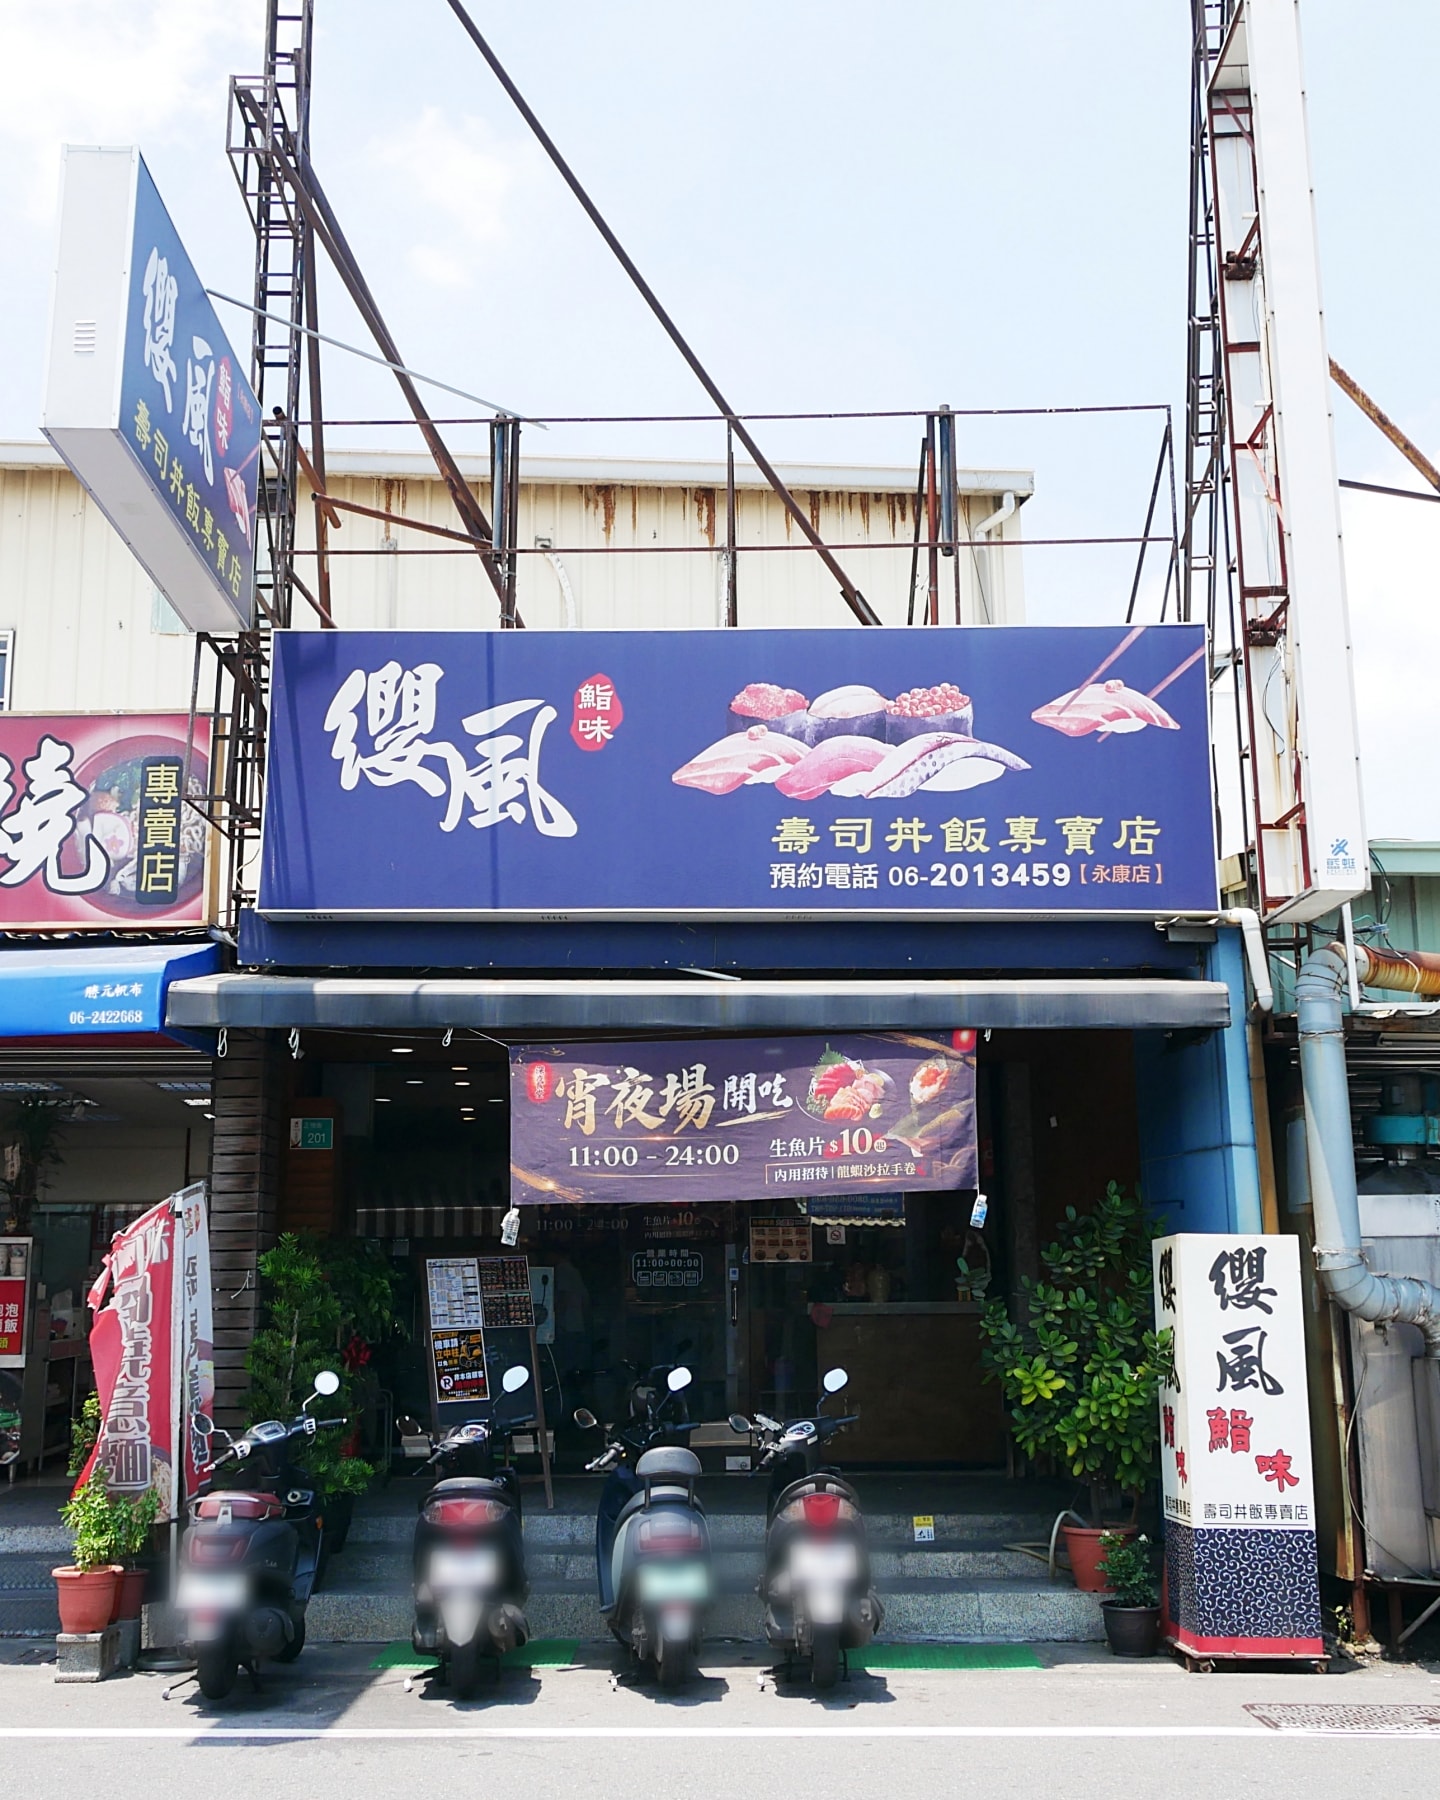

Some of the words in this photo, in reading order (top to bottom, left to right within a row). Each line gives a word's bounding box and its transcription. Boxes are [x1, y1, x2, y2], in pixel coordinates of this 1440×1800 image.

[134, 398, 242, 598] 壽司丼飯專賣店
[577, 683, 614, 743] 鮨味
[140, 764, 179, 894] 專賣店
[771, 816, 1162, 856] 壽司丼飯專賣店
[770, 863, 878, 889] 預約電話
[889, 863, 1071, 887] 06-2013459
[69, 1010, 143, 1024] 06-2422668
[556, 1063, 715, 1135] 宵夜場
[722, 1073, 794, 1115] 開吃
[307, 1133, 326, 1144] 201
[569, 1145, 638, 1168] 11:00
[665, 1142, 740, 1166] 24:00
[769, 1136, 826, 1158] 生魚片
[1206, 1406, 1300, 1493] 鮨味
[1203, 1503, 1309, 1520] 壽司丼飯專賣店
